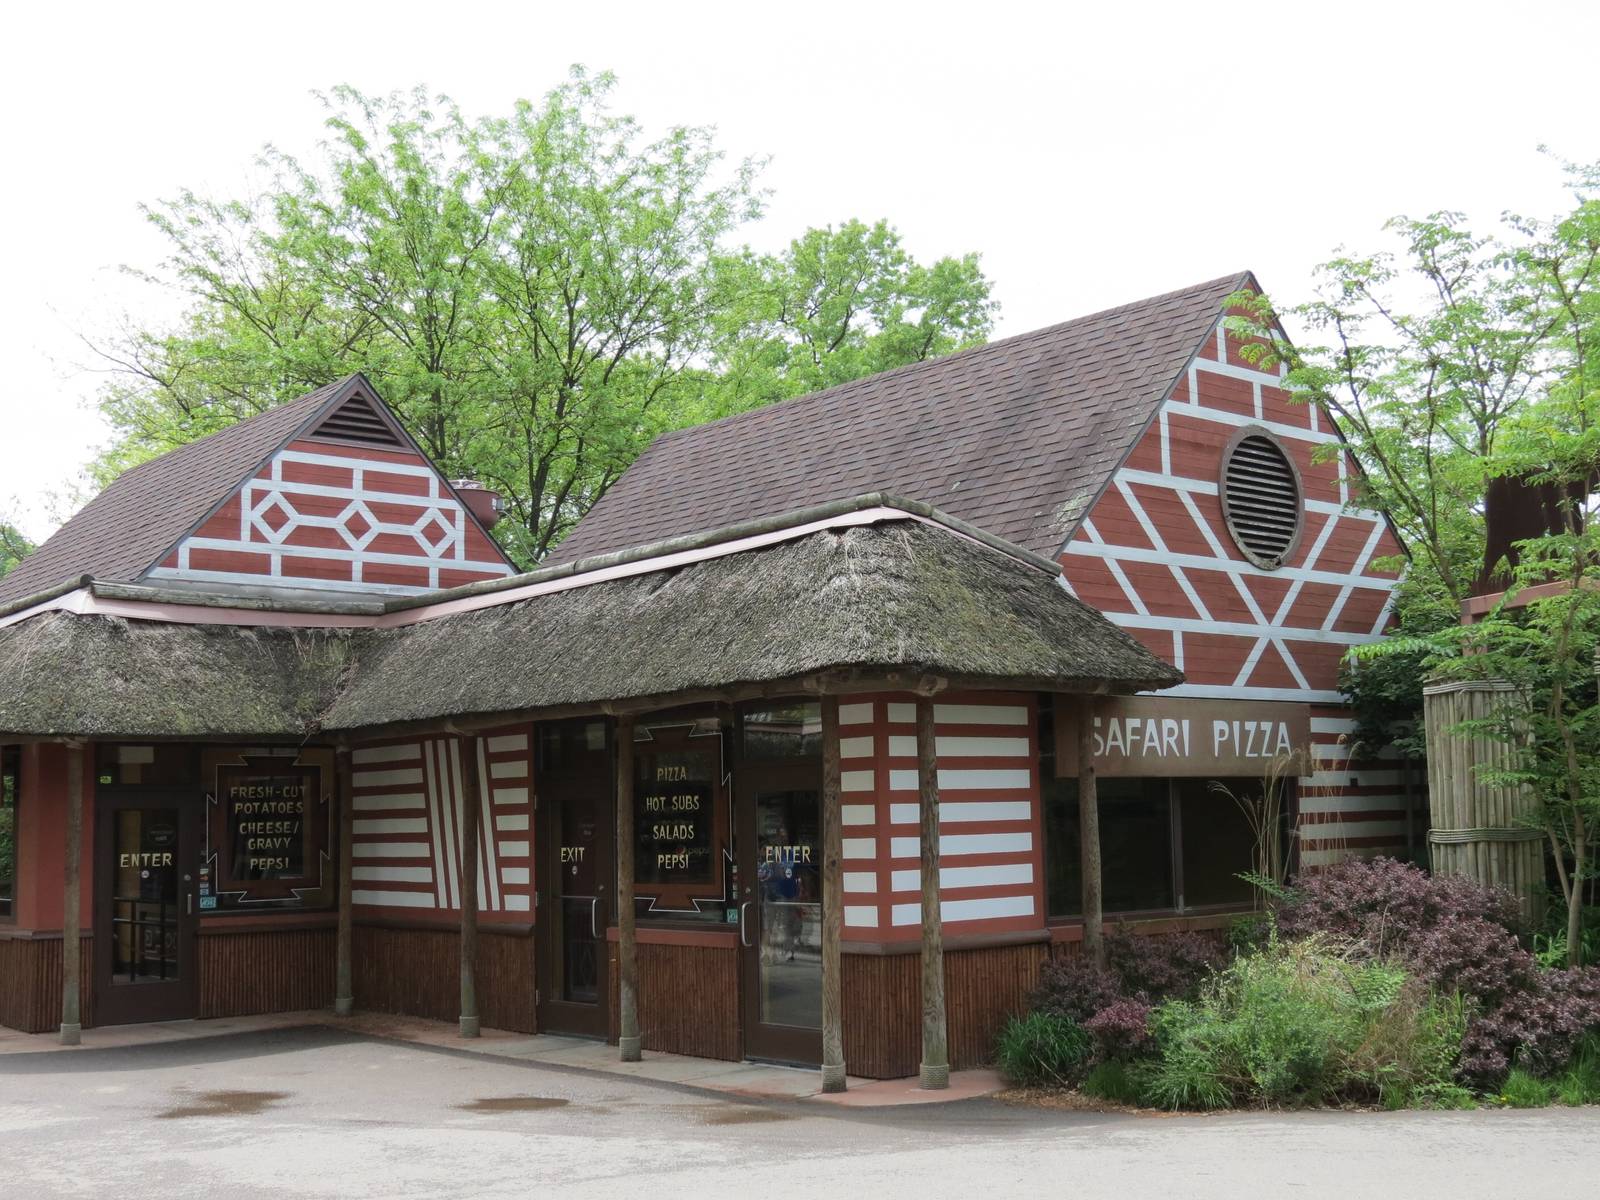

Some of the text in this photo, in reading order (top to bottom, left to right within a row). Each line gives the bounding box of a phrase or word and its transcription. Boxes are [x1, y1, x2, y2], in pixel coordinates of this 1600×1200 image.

[1093, 716, 1292, 758] SAFARI PIZZA
[657, 766, 687, 782] PIZZA
[230, 785, 308, 798] FRESH-CUT
[235, 802, 304, 814] POTATOES
[646, 795, 700, 812] HOT SUBS
[239, 821, 299, 834] CHEESE/
[652, 824, 695, 840] SALADS
[248, 837, 292, 850] GRAVY
[120, 852, 172, 868] ENTER
[560, 846, 585, 863] EXIT
[657, 853, 689, 869] PEPSI
[765, 845, 811, 864] ENTER
[250, 856, 289, 870] PEPSI
